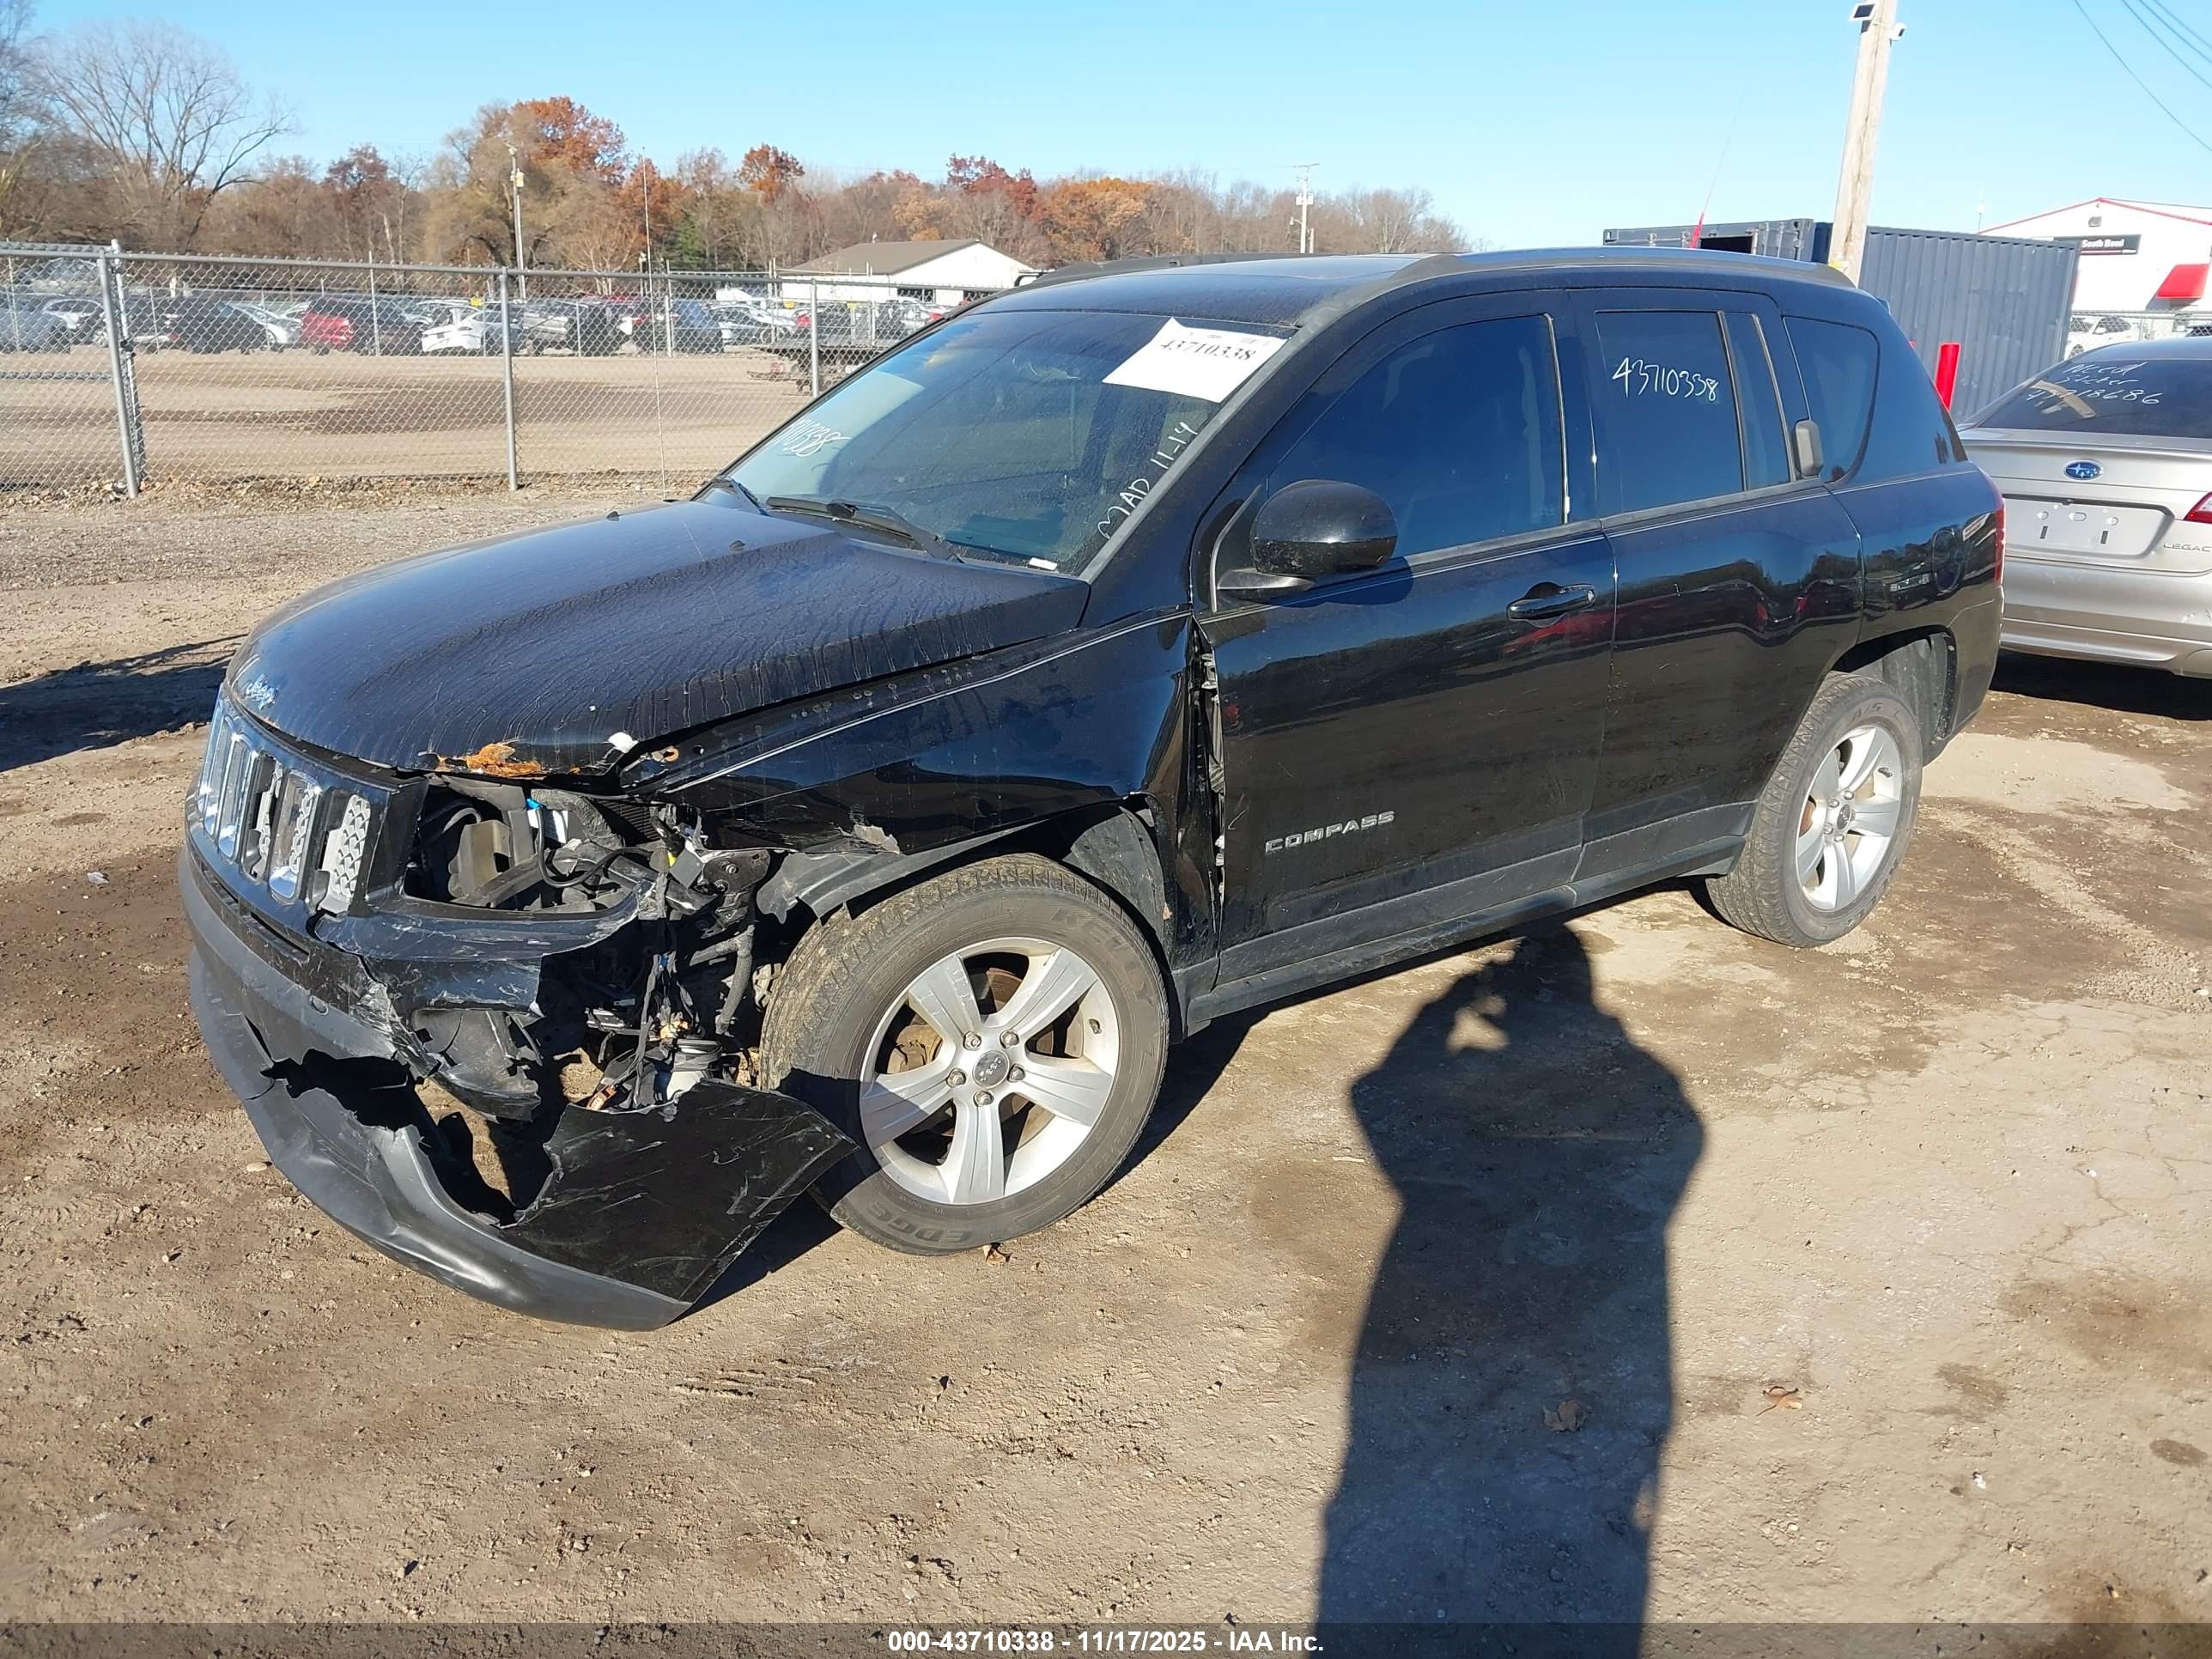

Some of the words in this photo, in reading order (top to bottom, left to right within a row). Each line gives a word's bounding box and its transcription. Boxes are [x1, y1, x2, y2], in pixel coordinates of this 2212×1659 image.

[1611, 357, 1719, 401] 43710338
[1265, 810, 1395, 854] COMPASS
[866, 1202, 974, 1243] EDGE
